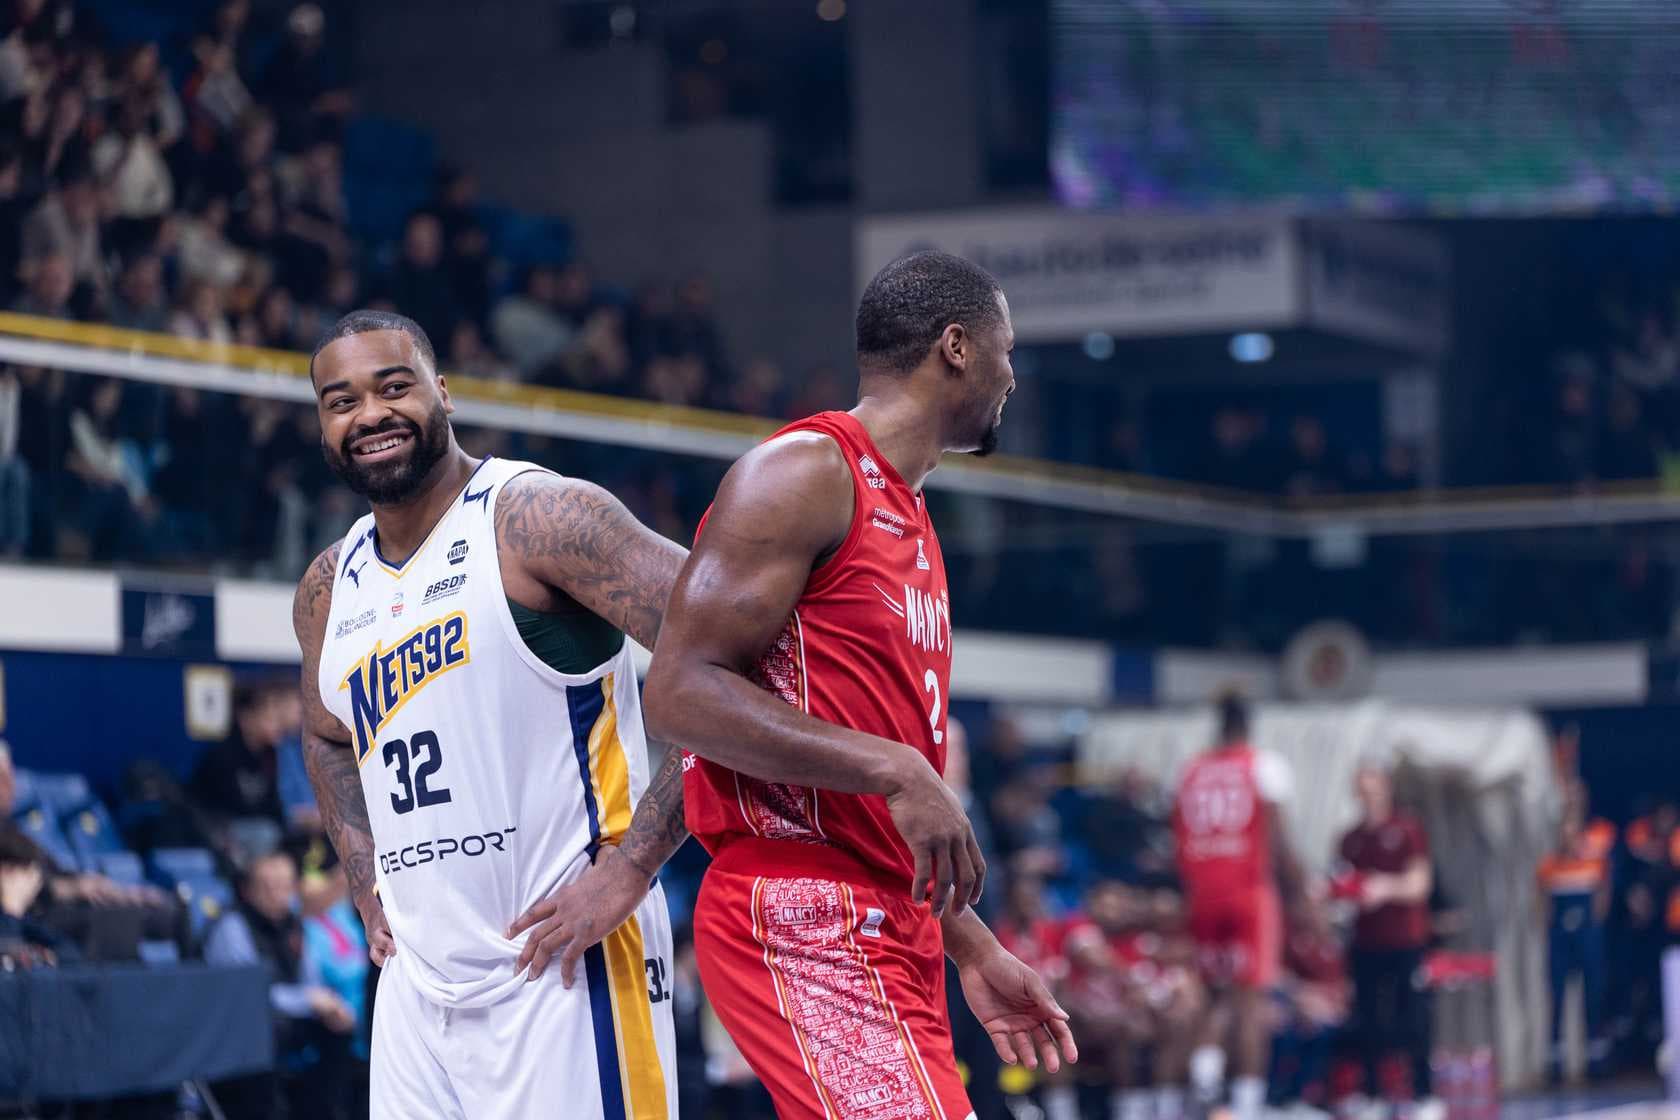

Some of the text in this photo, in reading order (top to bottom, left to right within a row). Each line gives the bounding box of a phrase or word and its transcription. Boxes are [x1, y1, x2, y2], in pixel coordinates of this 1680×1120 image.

[425, 576, 459, 598] BBSD
[925, 668, 944, 744] 2
[382, 729, 453, 815] 32
[681, 753, 697, 773] DF
[783, 907, 815, 921] NANCY
[853, 1085, 890, 1106] NANCY
